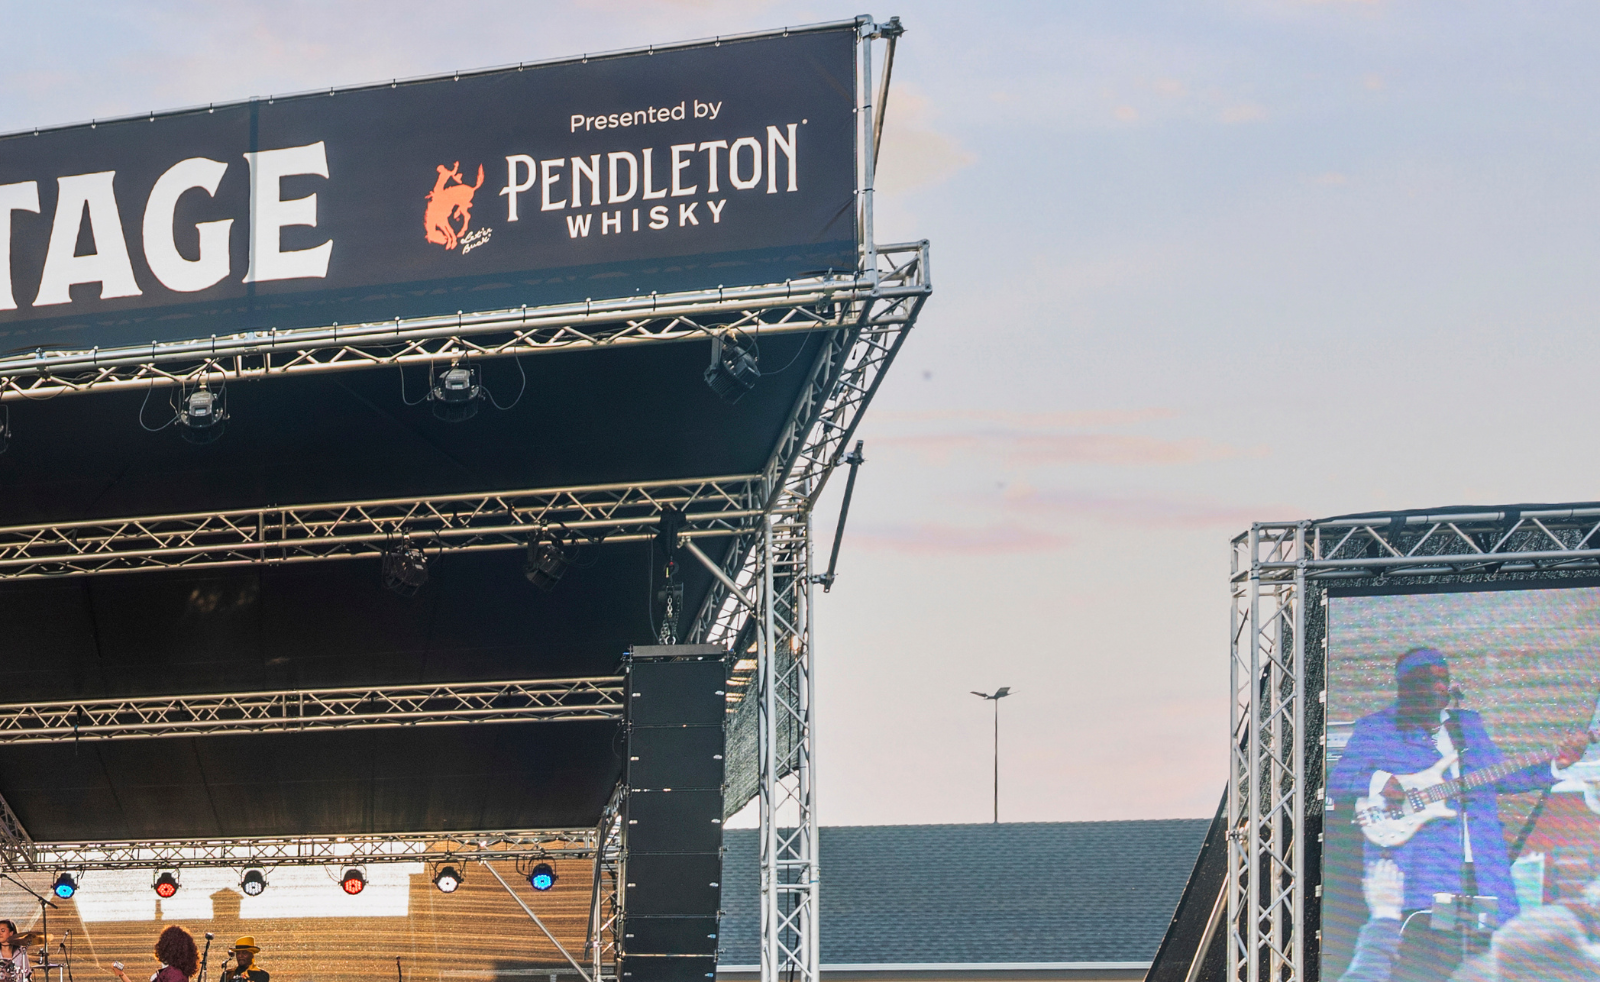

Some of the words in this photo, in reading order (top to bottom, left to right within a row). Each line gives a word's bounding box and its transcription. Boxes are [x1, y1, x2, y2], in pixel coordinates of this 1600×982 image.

[571, 101, 686, 133] Presented
[694, 100, 723, 120] by
[499, 123, 798, 222] PENDLETON
[567, 199, 727, 239] WHISKY
